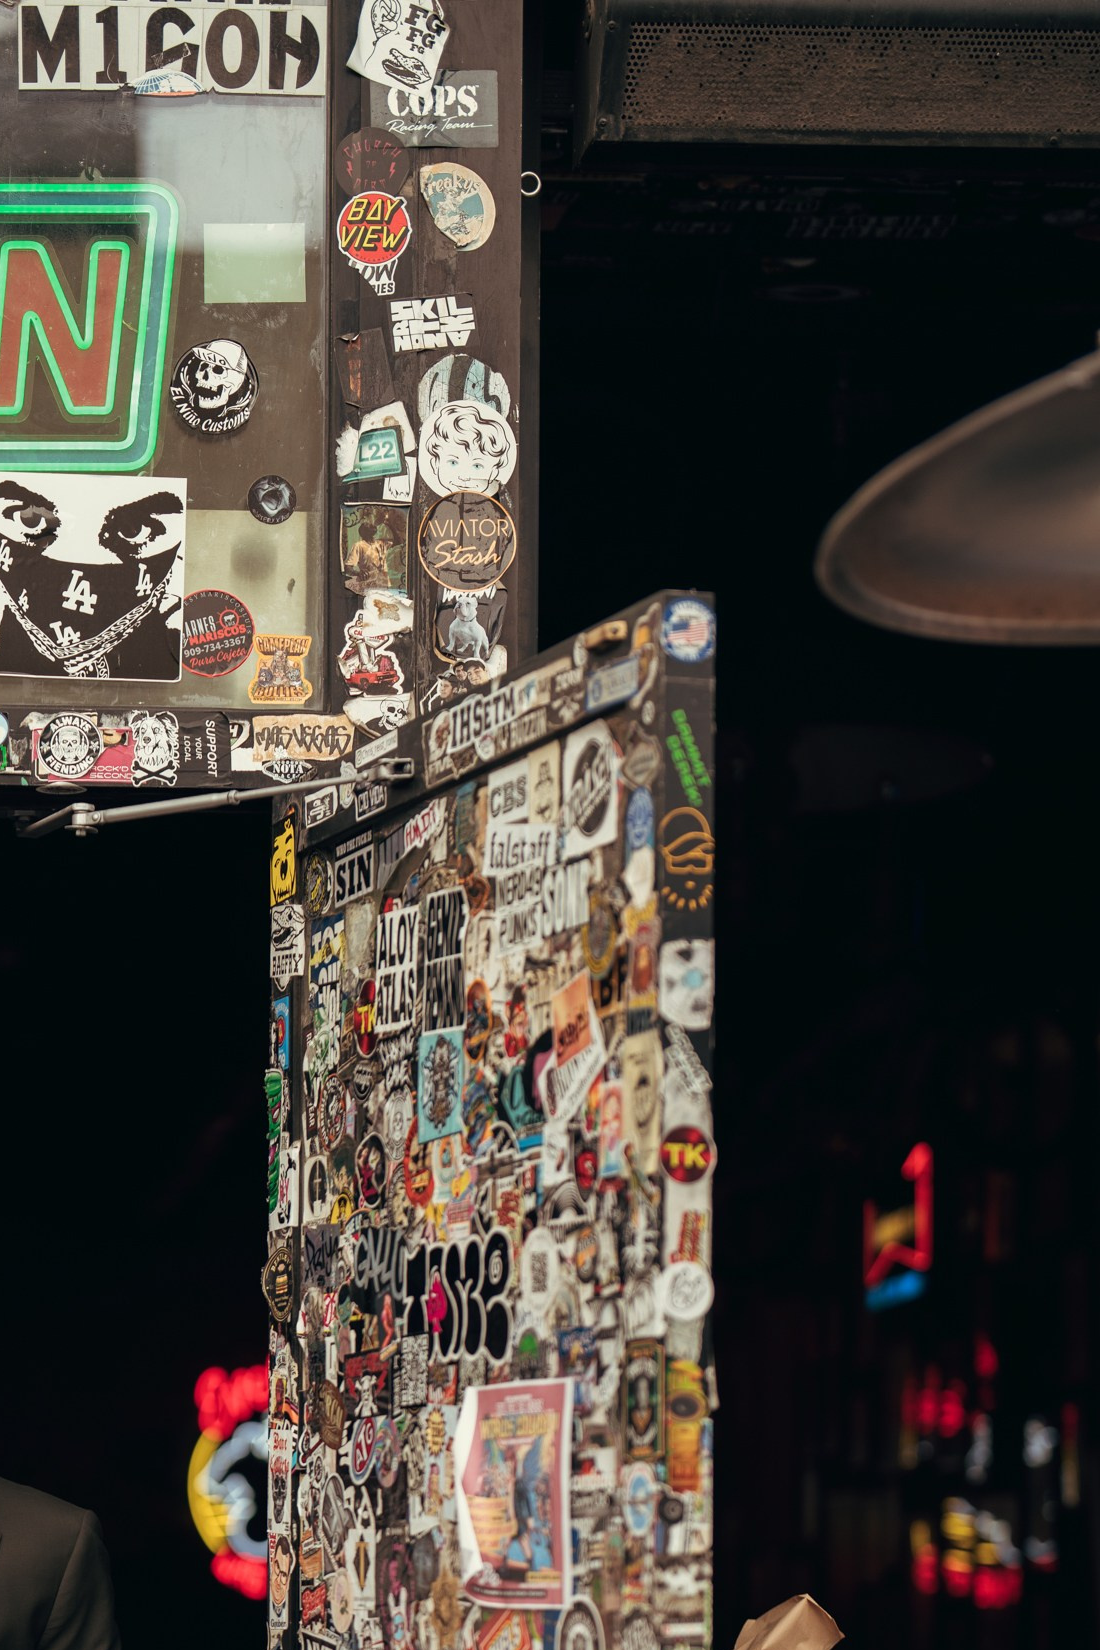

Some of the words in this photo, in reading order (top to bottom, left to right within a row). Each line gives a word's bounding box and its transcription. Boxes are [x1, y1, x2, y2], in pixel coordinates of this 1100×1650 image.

[405, 5, 445, 35] FG
[405, 26, 435, 49] FG
[387, 86, 479, 117] COPS
[386, 119, 439, 137] Racing
[441, 118, 494, 134] Team
[347, 198, 398, 223] BAY
[339, 226, 406, 249] VIEW
[201, 407, 251, 432] Customs
[423, 517, 509, 538] AVIATOR
[434, 541, 501, 567] Stash
[189, 624, 246, 646] MARISCOS
[183, 637, 247, 658] 909-734-3367
[190, 653, 213, 667] Pura
[255, 685, 306, 698] BULLIES
[49, 718, 91, 735] ALWAYS
[183, 736, 192, 762] LOCAL
[195, 736, 203, 761] YOUR
[205, 720, 217, 778] SUPPORT
[44, 754, 94, 776] FIENDING
[273, 765, 305, 774] NOTA
[336, 850, 373, 903] SIN
[664, 1142, 708, 1168] TK
